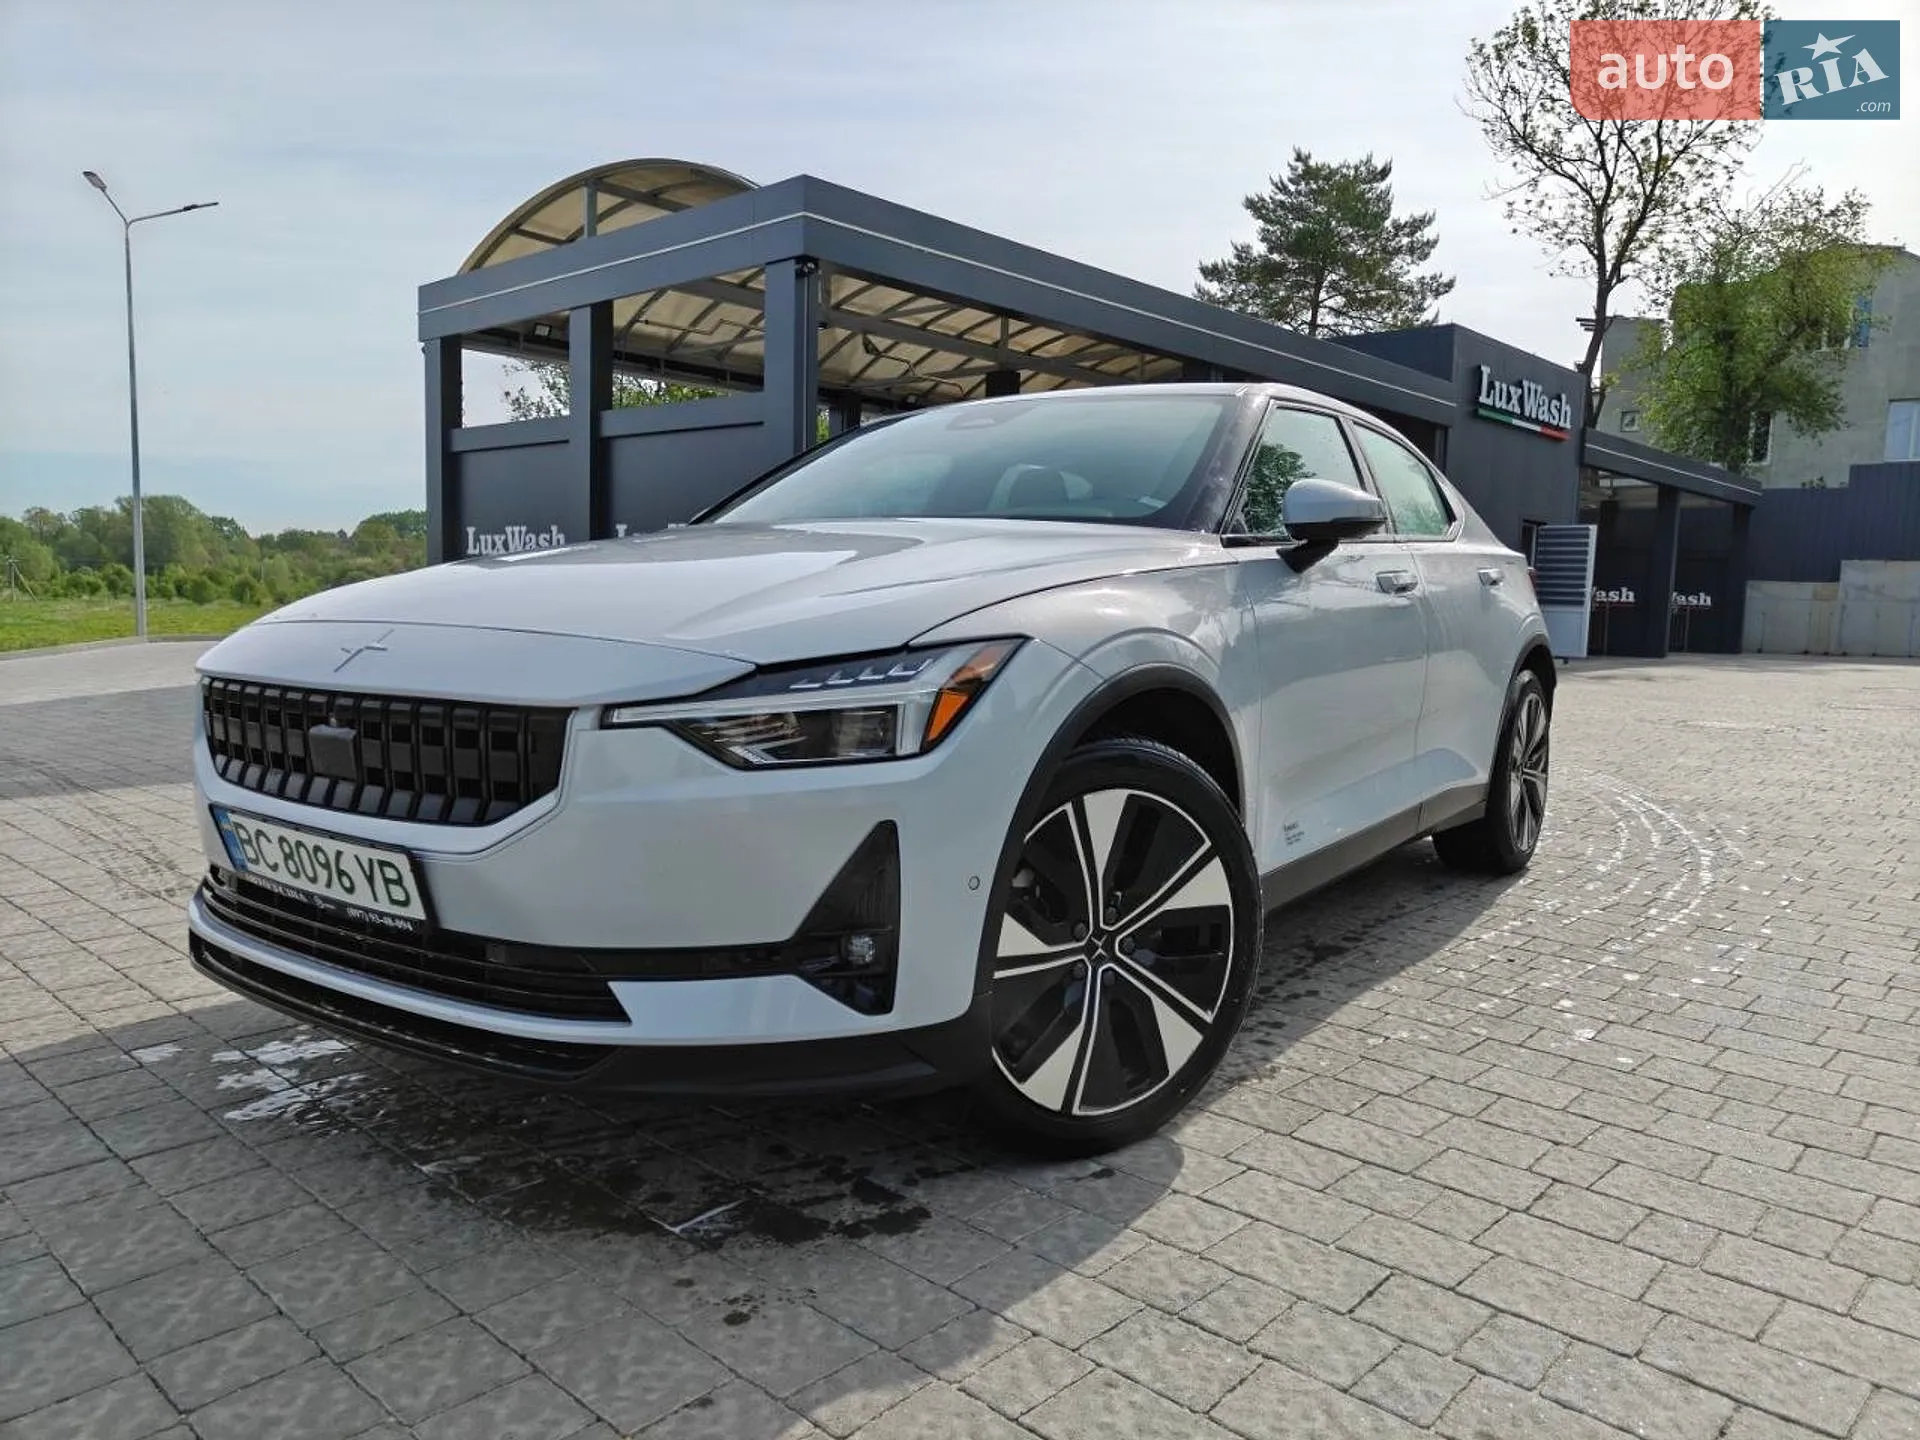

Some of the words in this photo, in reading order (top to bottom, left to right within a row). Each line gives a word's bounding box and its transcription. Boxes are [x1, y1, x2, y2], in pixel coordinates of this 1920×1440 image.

[1479, 365, 1571, 429] LuxWash
[466, 525, 565, 554] LuxWash
[233, 821, 279, 872] BC
[277, 835, 355, 895] 8096
[354, 854, 412, 907] YB
